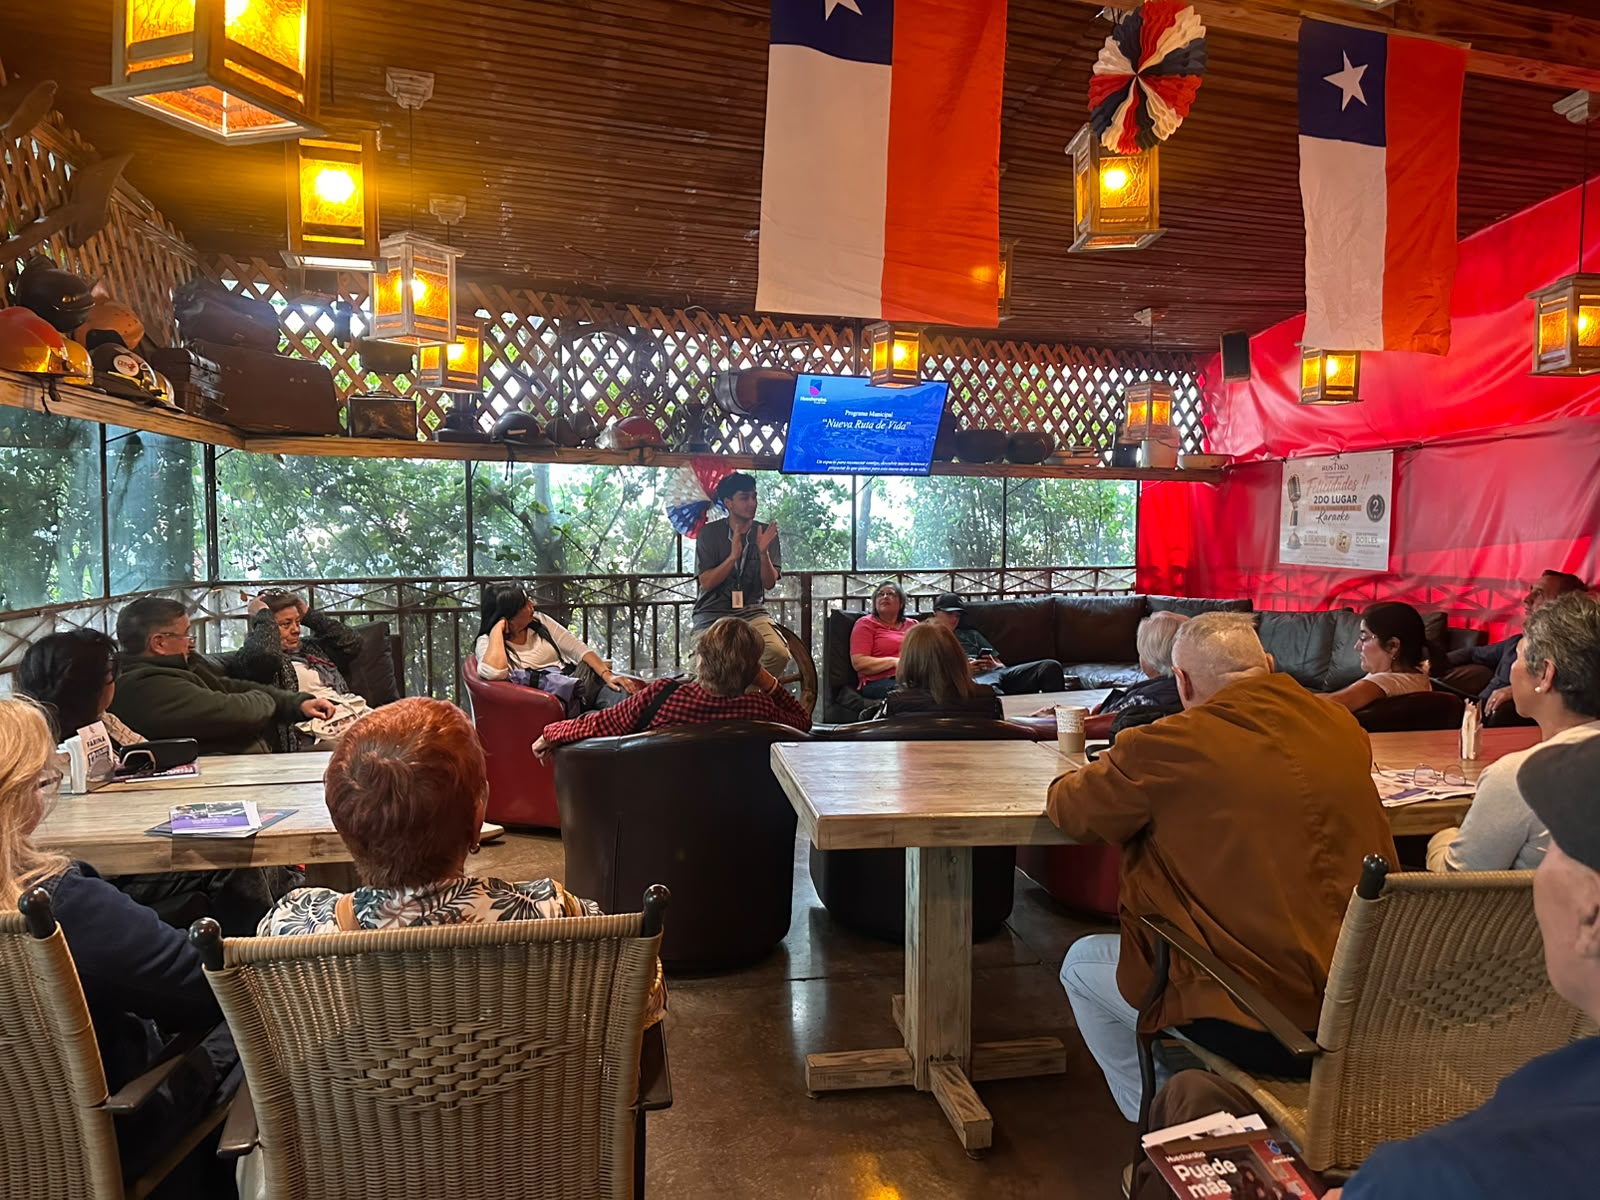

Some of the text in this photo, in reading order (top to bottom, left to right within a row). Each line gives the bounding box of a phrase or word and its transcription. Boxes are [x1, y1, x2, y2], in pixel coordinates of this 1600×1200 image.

[844, 410, 868, 418] Programa
[854, 419, 874, 429] Ruta
[875, 420, 887, 429] de
[1313, 495, 1357, 504] 2DO LUGAR
[1372, 499, 1379, 512] 2
[1315, 509, 1350, 525] Karaoke
[1165, 1151, 1206, 1163] Huechuraba
[1172, 1158, 1237, 1181] Puede
[1187, 1177, 1232, 1199] más
